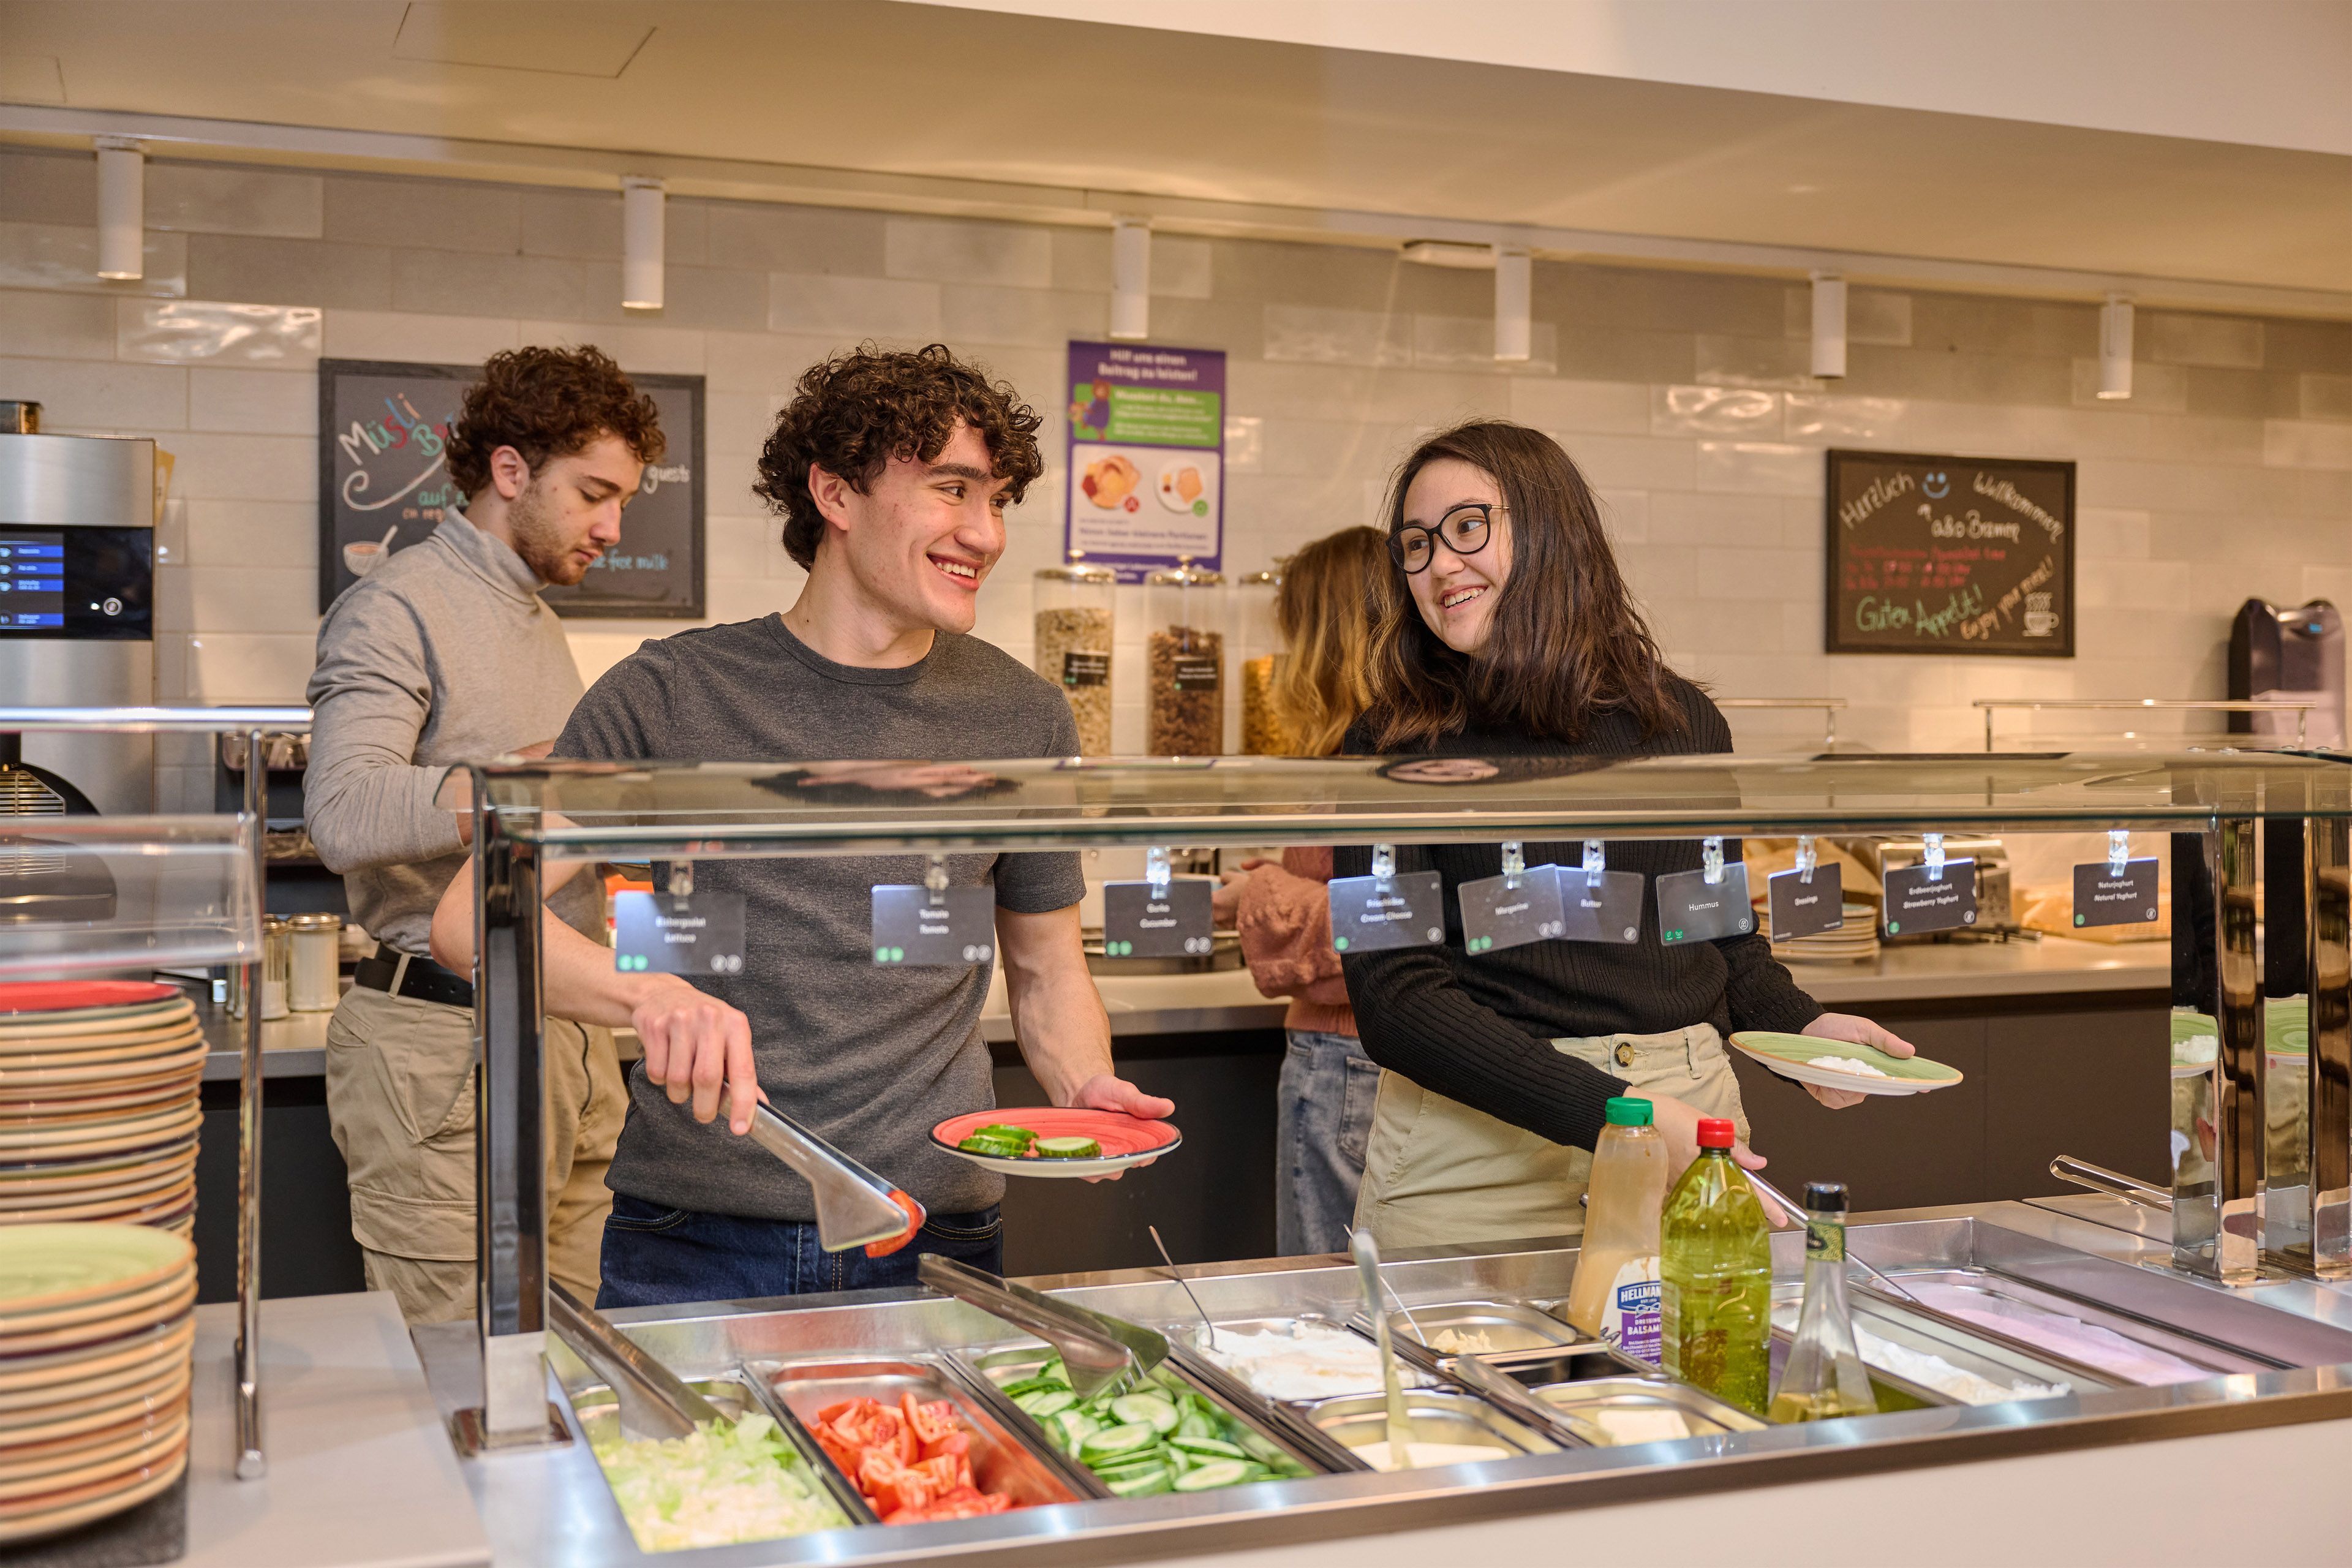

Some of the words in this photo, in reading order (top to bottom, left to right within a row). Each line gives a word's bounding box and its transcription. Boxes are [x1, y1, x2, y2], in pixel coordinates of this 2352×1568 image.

[338, 393, 421, 466] Müsli
[1909, 883, 1953, 895] Erdbeerjoghurt
[2098, 880, 2133, 889] Naturjoghurt
[1903, 899, 1936, 909] Strawberry
[1936, 894, 1959, 905] Yoghurt
[2116, 892, 2137, 901] Yoghurt
[1689, 902, 1719, 911] Hummus
